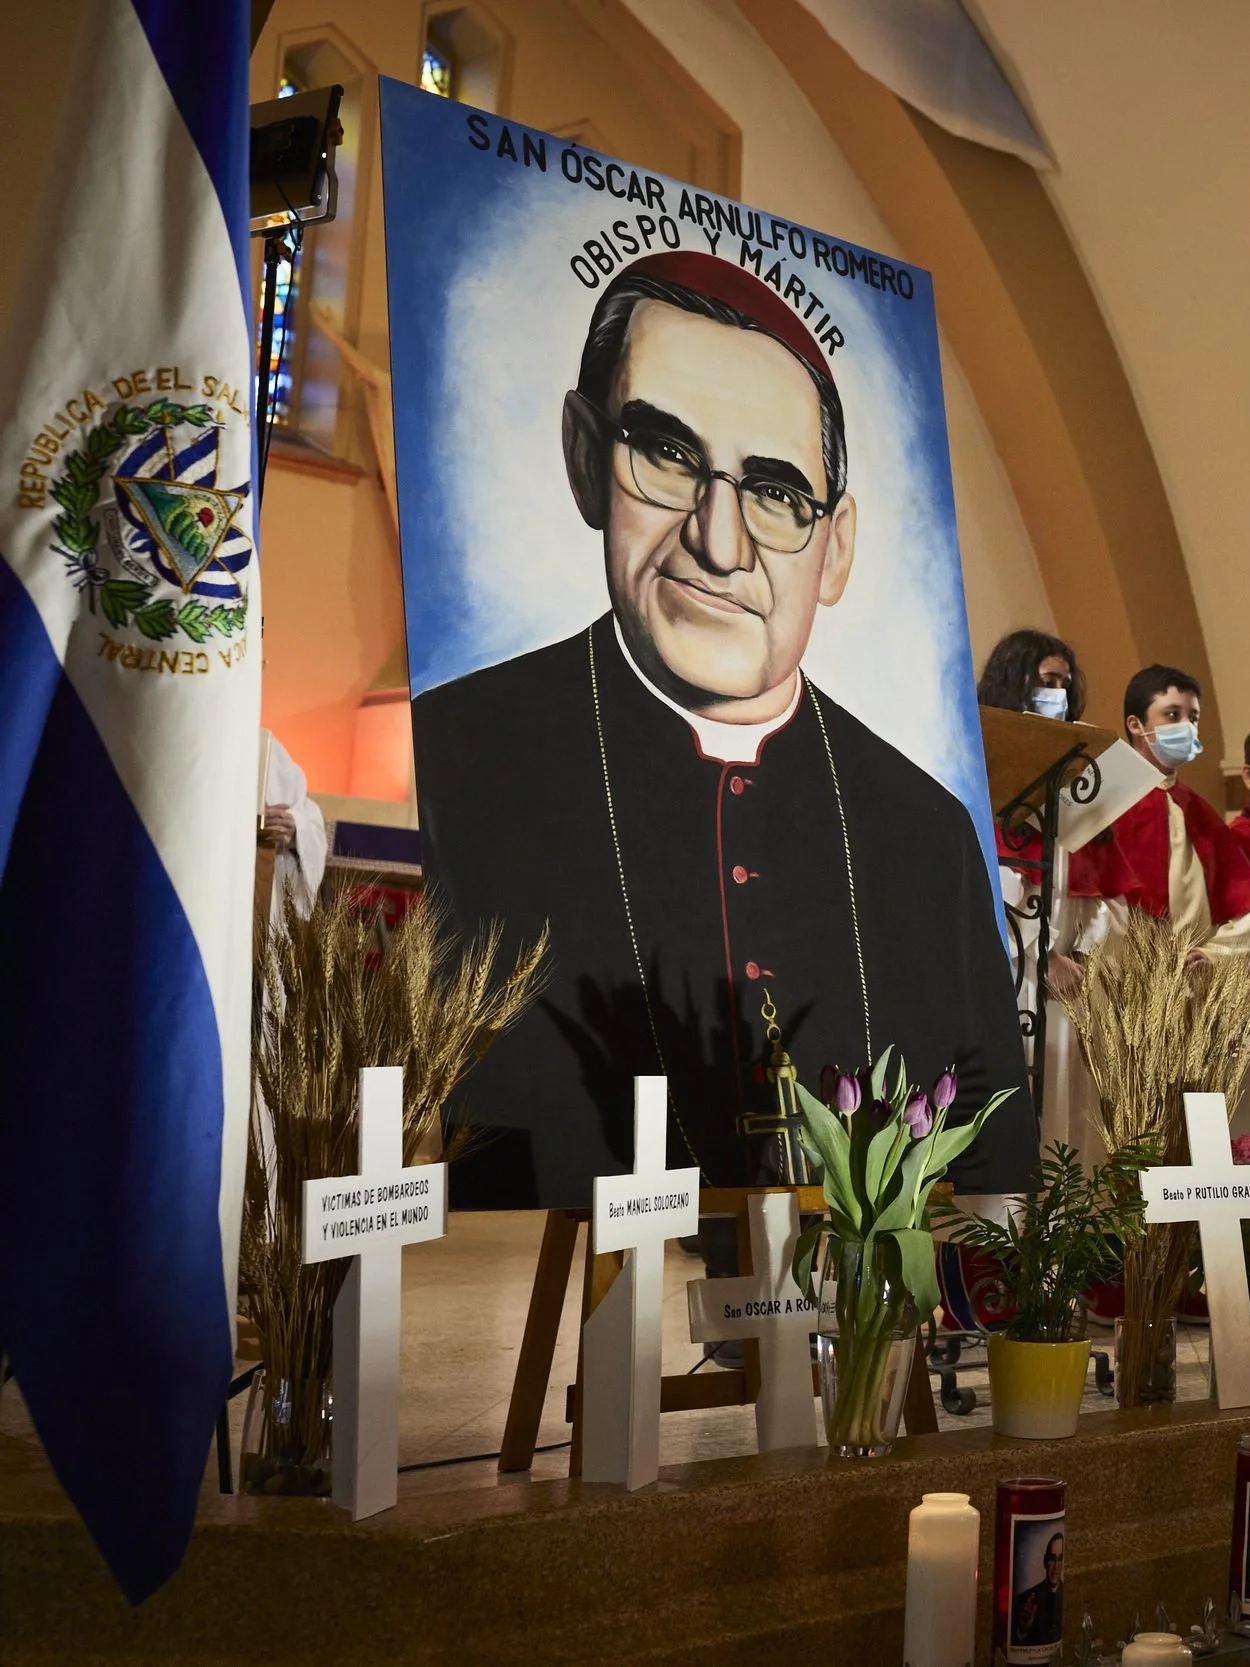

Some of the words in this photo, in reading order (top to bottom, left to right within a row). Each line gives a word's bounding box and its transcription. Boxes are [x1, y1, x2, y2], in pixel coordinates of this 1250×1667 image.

[467, 113, 547, 172] SAN
[561, 143, 667, 213] ÓSCAR
[678, 188, 806, 260] ARNULFO
[814, 237, 915, 300] ROMERO
[569, 214, 681, 289] OBISPO
[702, 226, 721, 256] Y
[738, 239, 846, 357] MÁRTIR
[17, 388, 109, 510] REPUBLICA
[112, 369, 151, 400] DE
[156, 366, 192, 392] EL
[97, 632, 210, 676] CENTRAL
[321, 1190, 361, 1212] VICTIMAS
[364, 1188, 375, 1205] DE
[377, 1179, 429, 1203] BOMBARDEOS
[608, 1202, 625, 1218] Beato
[626, 1197, 652, 1216] MANUEL
[653, 1191, 690, 1212] SOLORZANO
[1162, 1188, 1184, 1201] Beato
[1186, 1187, 1192, 1200] P
[1195, 1186, 1229, 1200] RUTILIO
[322, 1223, 329, 1240] Y
[331, 1215, 374, 1239] VIOLENCIA
[376, 1212, 387, 1231] EN
[390, 1210, 399, 1228] EL
[401, 1205, 429, 1226] MUNDO
[723, 1303, 742, 1319] San
[745, 1299, 781, 1316] OSCAR
[785, 1299, 793, 1313] A
